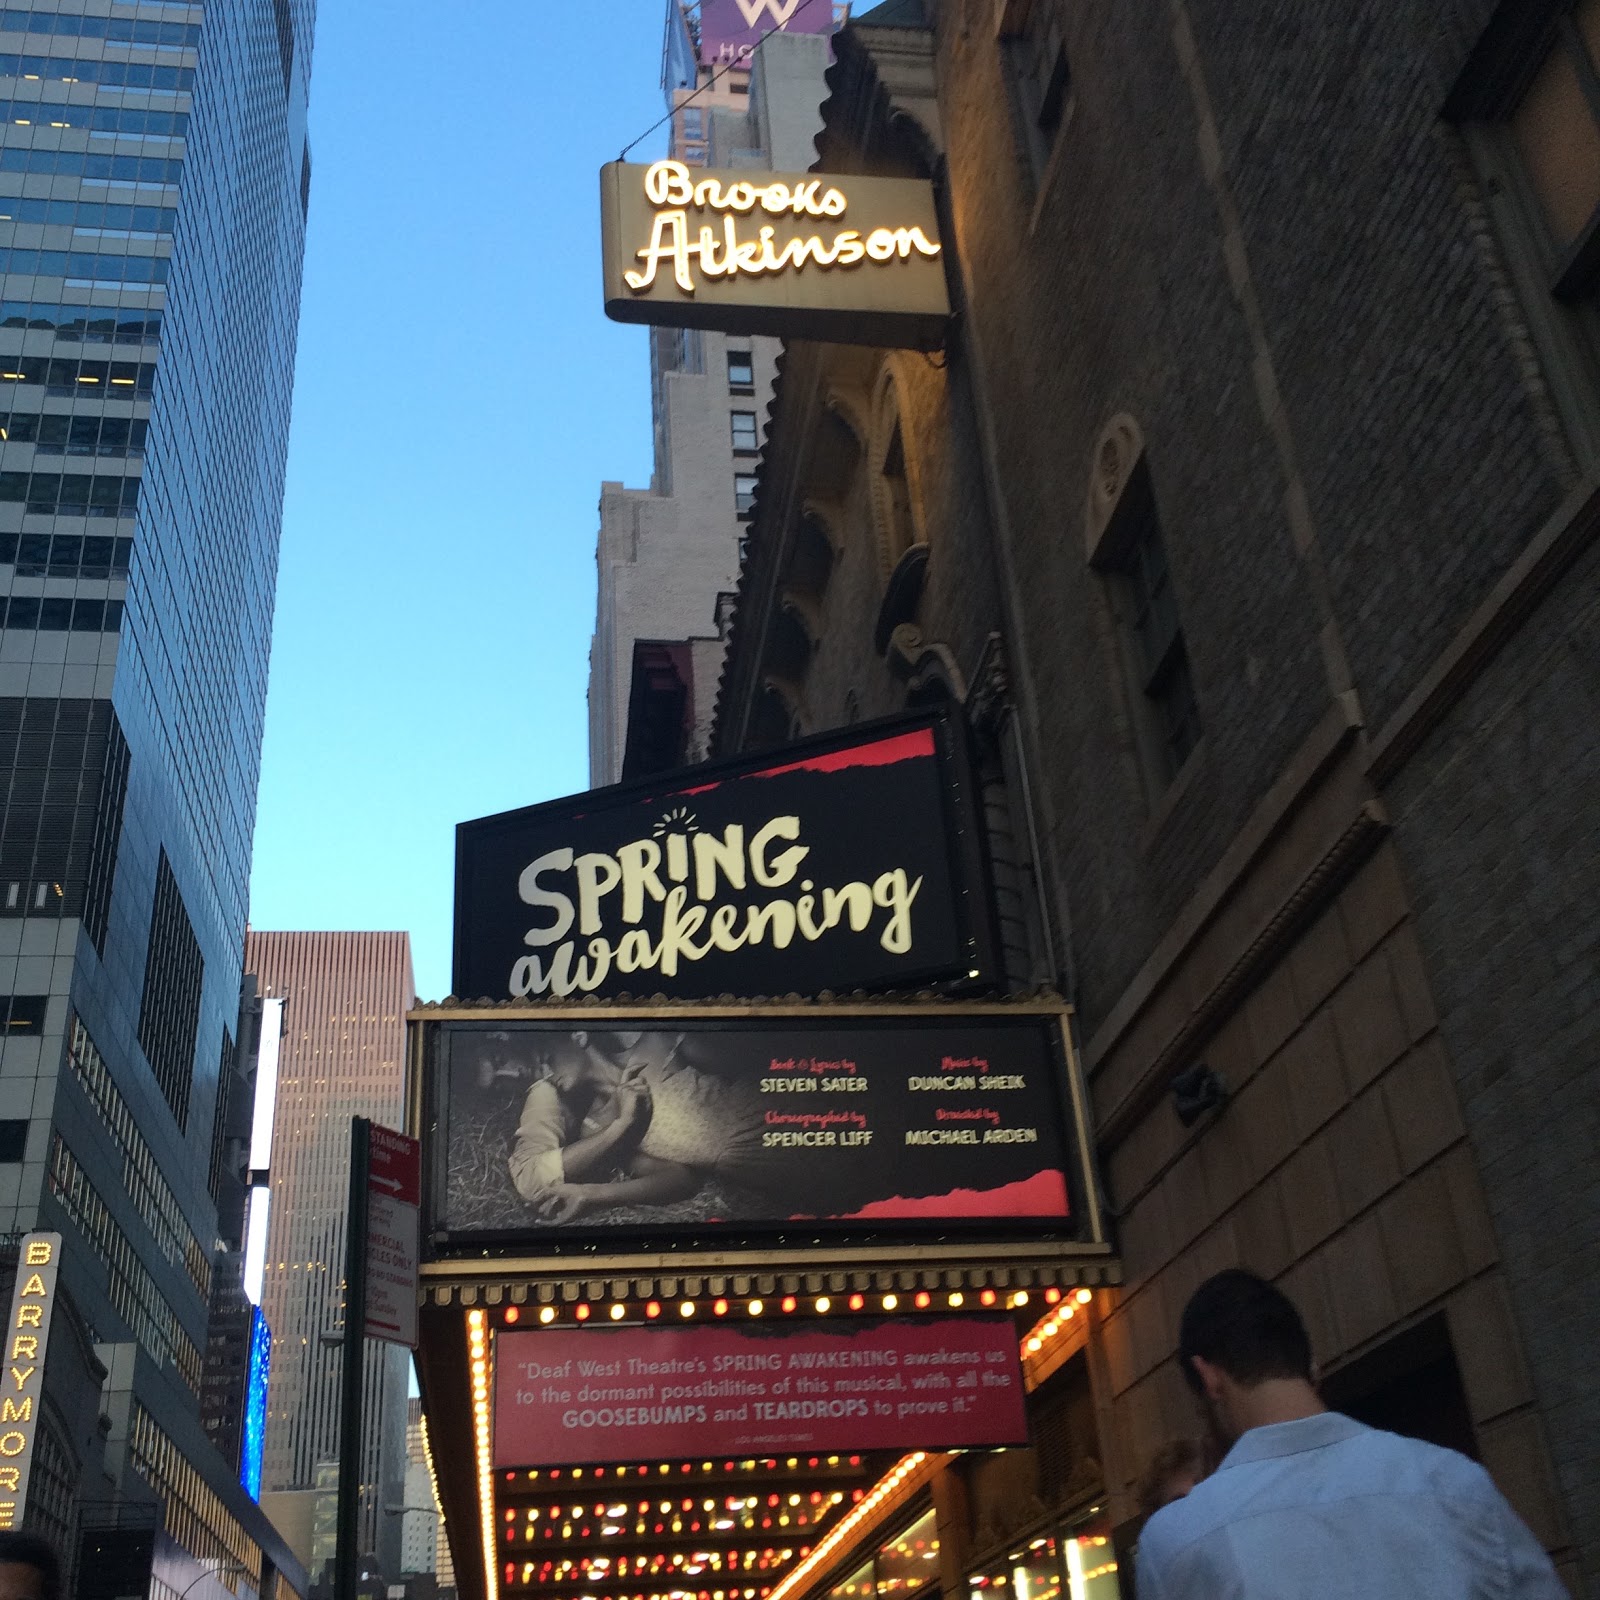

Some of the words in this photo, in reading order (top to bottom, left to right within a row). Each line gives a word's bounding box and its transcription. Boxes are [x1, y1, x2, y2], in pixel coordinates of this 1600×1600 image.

[645, 160, 847, 216] Brooks
[624, 210, 941, 291] Atkinson
[518, 815, 810, 947] SPRING
[508, 867, 924, 999] awakening
[759, 1077, 818, 1093] STEVEN
[820, 1077, 869, 1092] SATER
[907, 1075, 976, 1091] DUNCAN
[978, 1074, 1027, 1090] SHEIK
[762, 1131, 837, 1147] SPENCER
[839, 1130, 873, 1146] LIFF
[905, 1129, 981, 1145] MICHAEL
[982, 1128, 1038, 1144] ARDEN
[577, 1360, 621, 1377] West
[627, 1357, 707, 1376] Theatre's
[712, 1353, 782, 1372] SPRING
[788, 1349, 898, 1369] AWAKENING
[903, 1348, 981, 1366] awakens
[985, 1350, 1007, 1363] us
[515, 1389, 535, 1405] to
[541, 1386, 571, 1404] the
[577, 1384, 655, 1402] dormant
[661, 1379, 767, 1404] possibilities
[771, 1377, 792, 1395] of
[796, 1376, 829, 1393] this
[834, 1373, 908, 1393] musical,
[911, 1371, 951, 1389] with
[956, 1371, 978, 1388] all
[982, 1370, 1012, 1387] the
[562, 1404, 707, 1429] GOOSEBUMPS
[713, 1403, 748, 1422] and
[754, 1399, 869, 1420] TEARDROPS
[873, 1400, 893, 1416] to
[897, 1400, 949, 1419] prove
